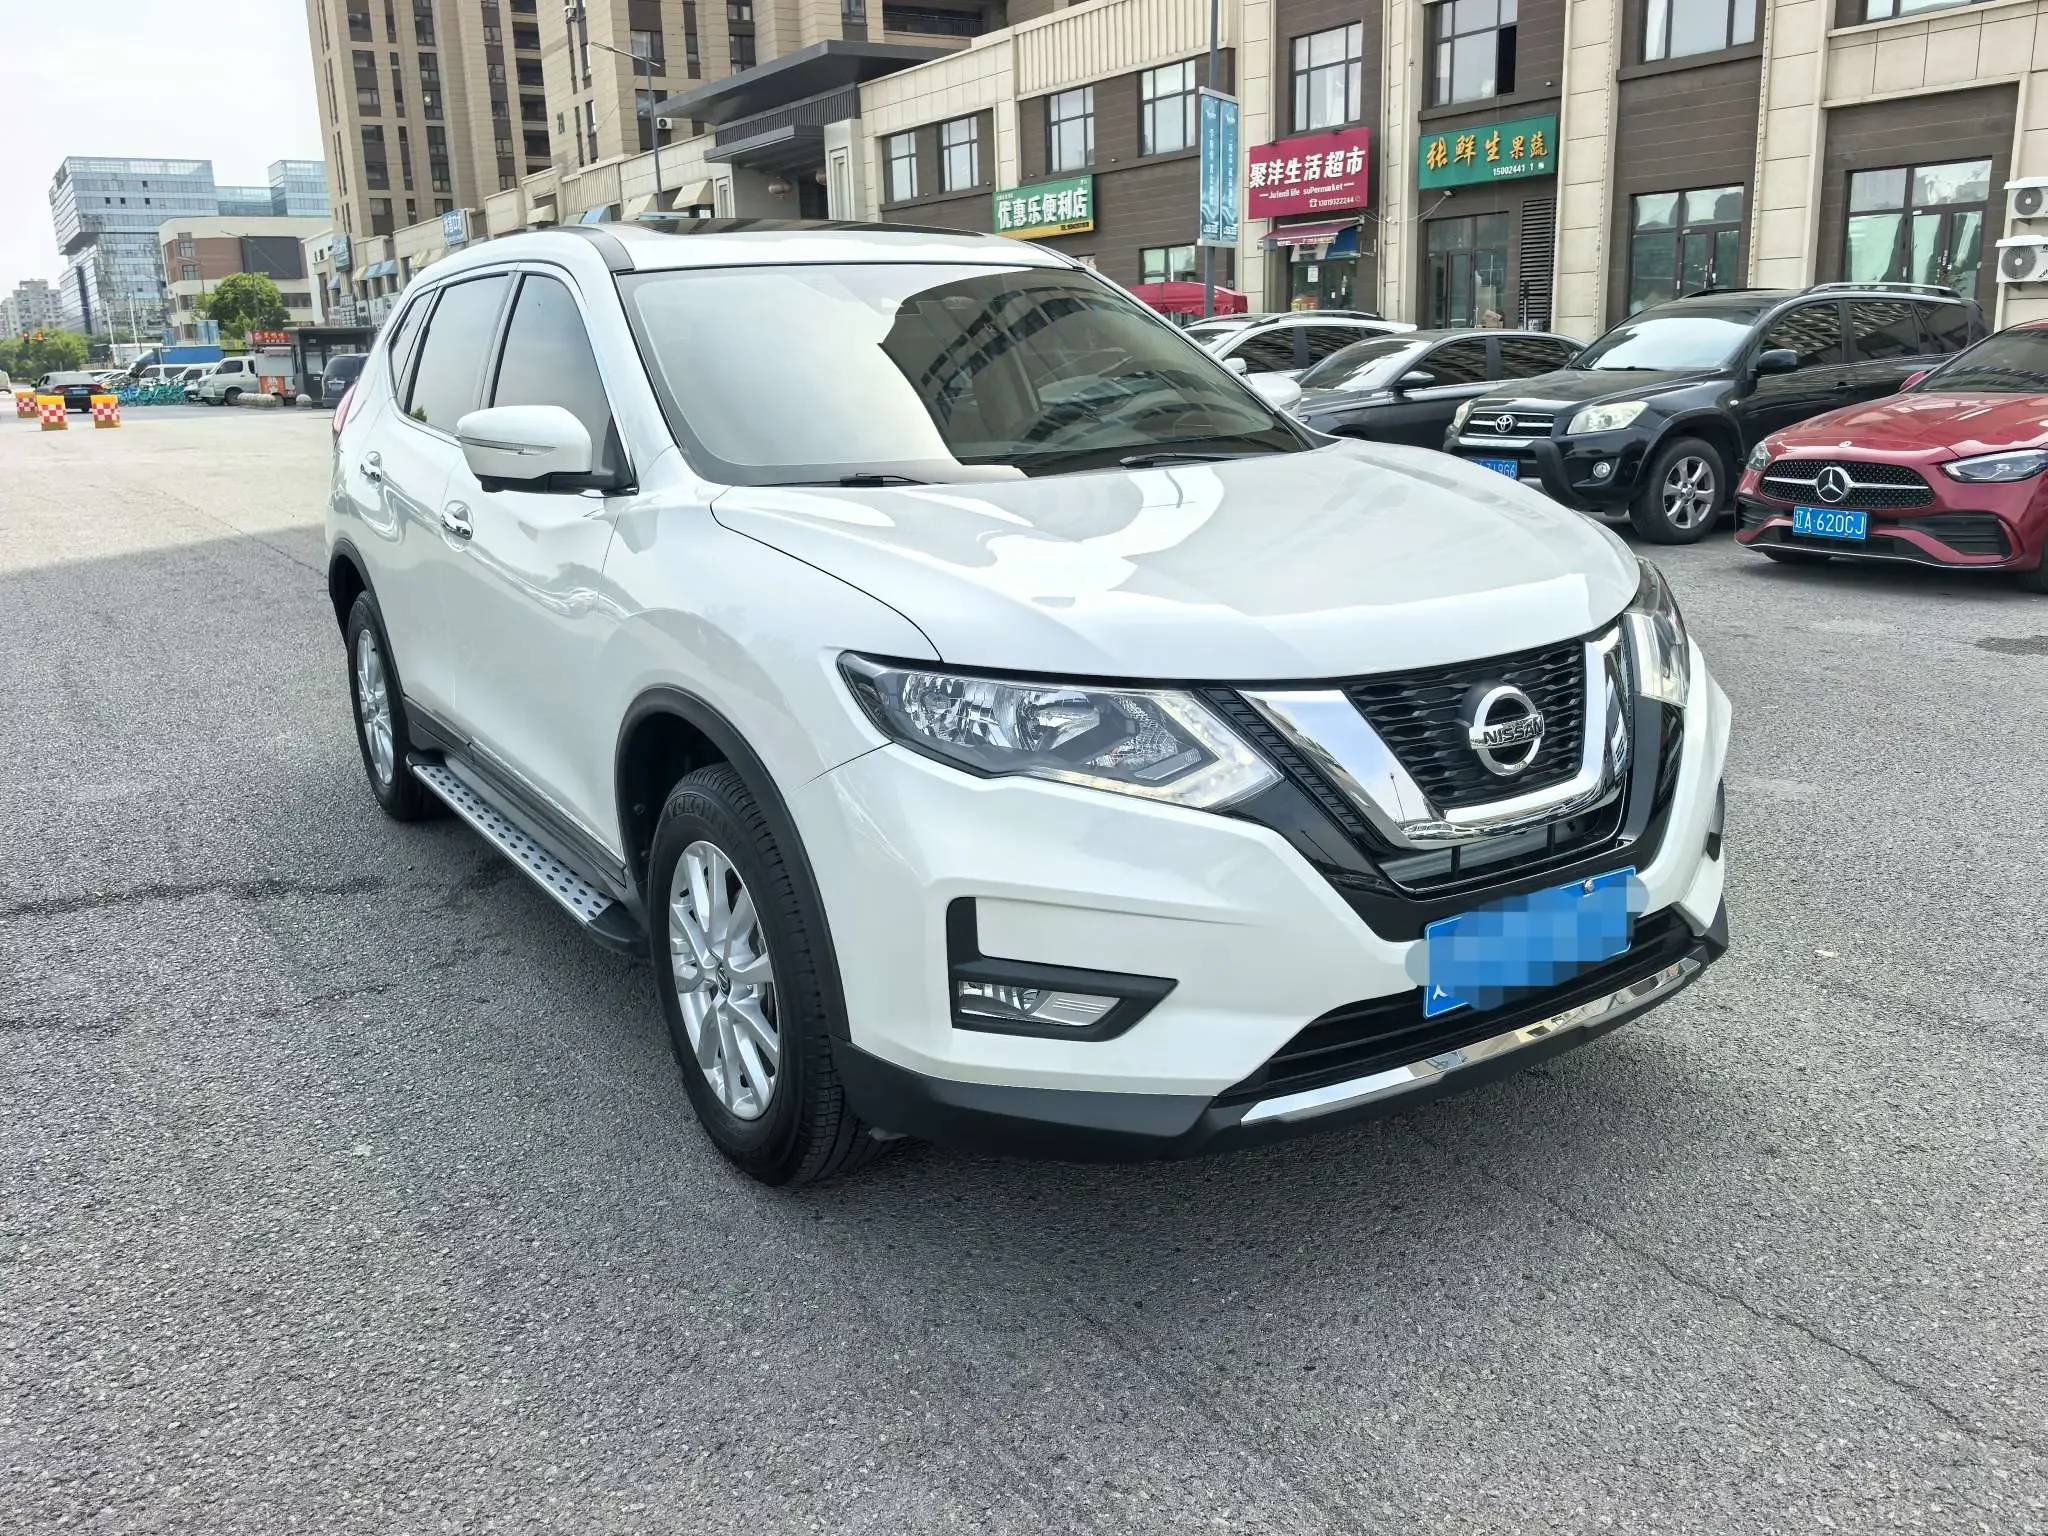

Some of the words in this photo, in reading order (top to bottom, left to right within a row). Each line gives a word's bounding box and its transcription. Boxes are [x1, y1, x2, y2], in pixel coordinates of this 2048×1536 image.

[998, 187, 1088, 229] 优惠乐便利店
[1483, 716, 1543, 745] NISSAN
